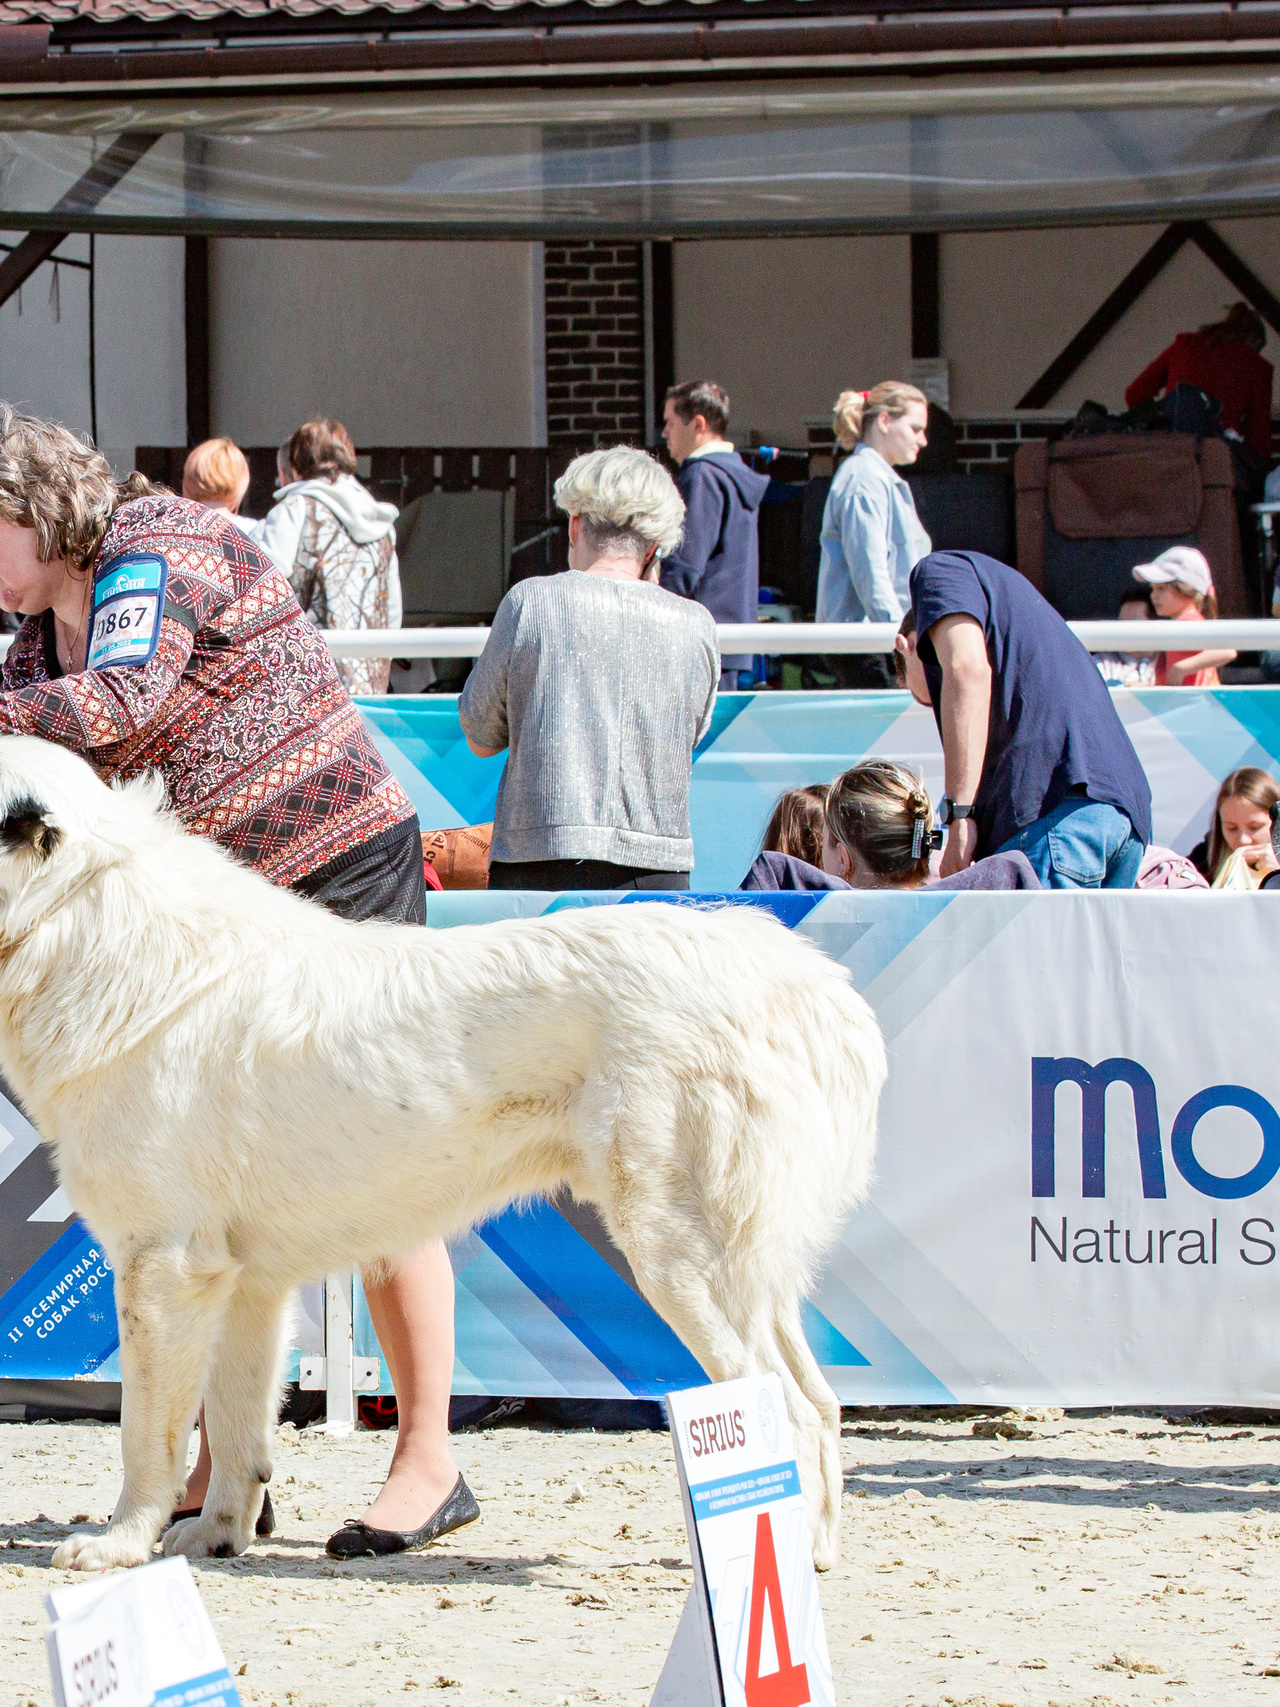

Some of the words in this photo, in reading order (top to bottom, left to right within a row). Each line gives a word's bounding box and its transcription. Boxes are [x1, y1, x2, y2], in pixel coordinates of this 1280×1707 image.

[1031, 1056, 1280, 1201] mo
[1030, 1216, 1218, 1265] Natural
[1239, 1217, 1277, 1266] S
[22, 1248, 100, 1328] ВСЕМИРНАЯ
[36, 1294, 80, 1339] СОБАК
[689, 1409, 746, 1458] SIRIUS
[744, 1511, 812, 1707] 4
